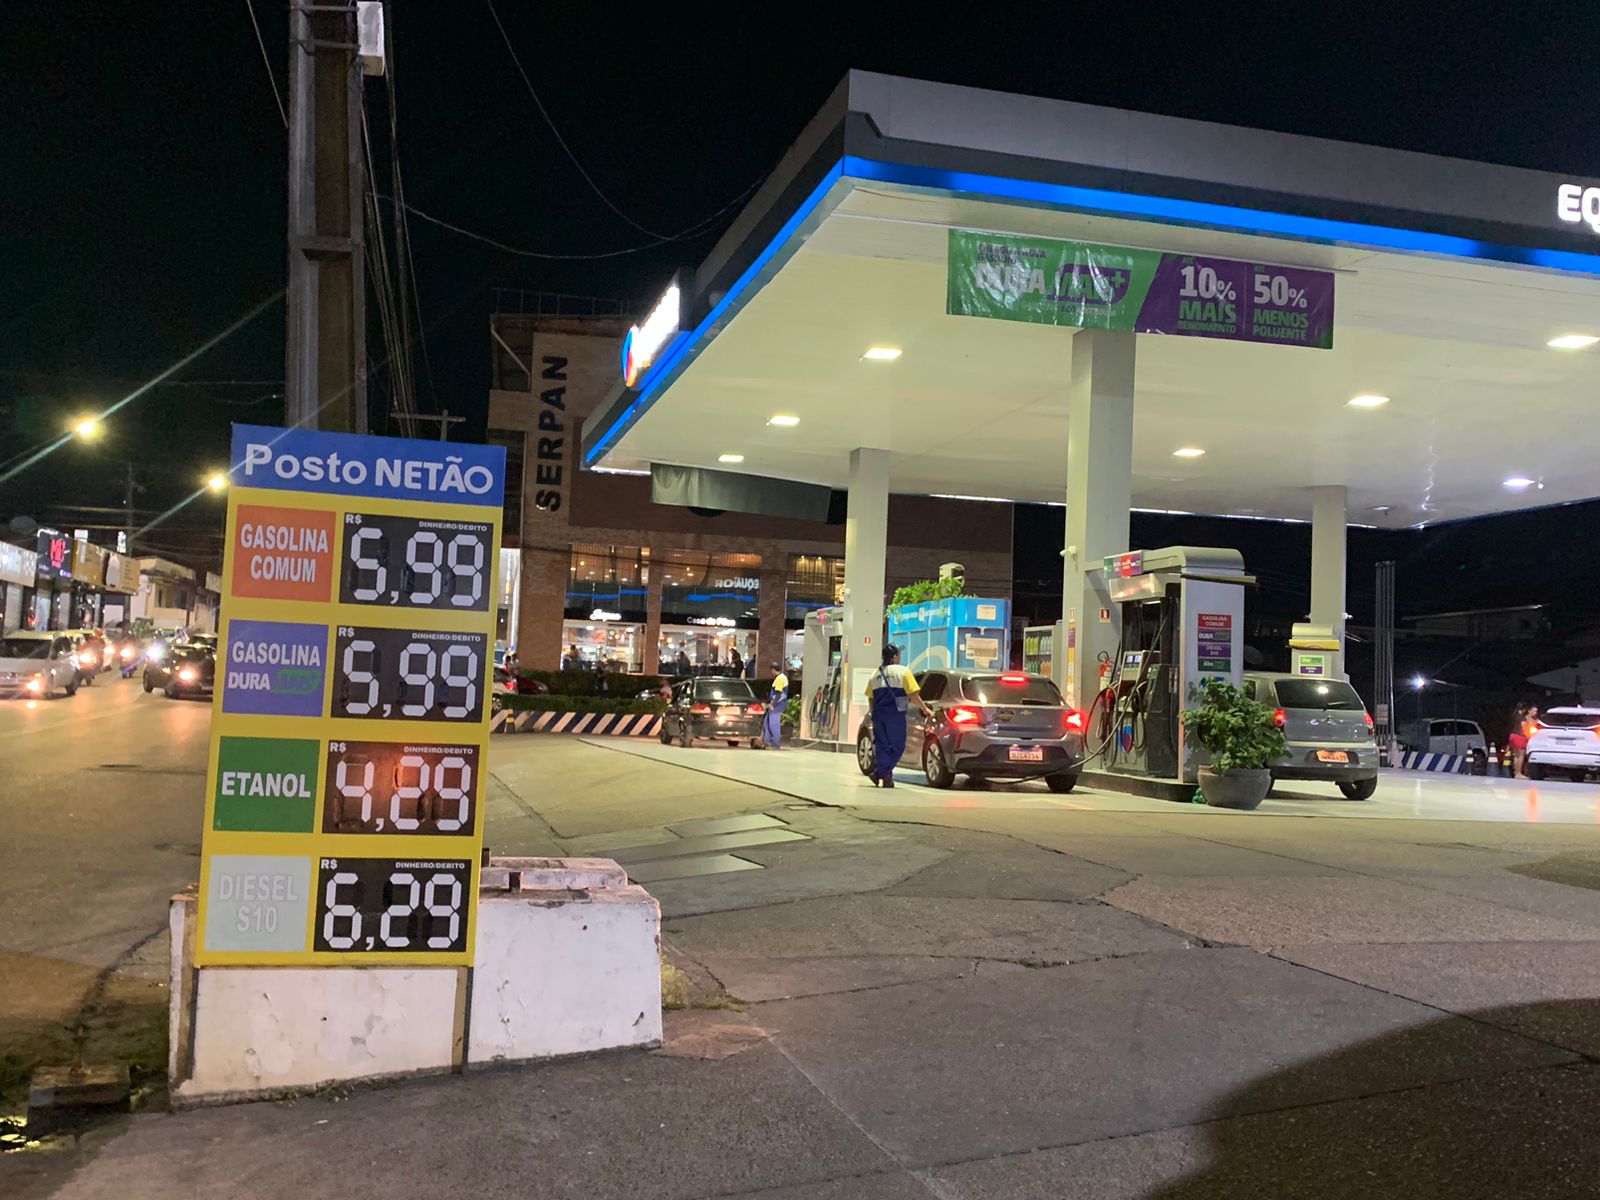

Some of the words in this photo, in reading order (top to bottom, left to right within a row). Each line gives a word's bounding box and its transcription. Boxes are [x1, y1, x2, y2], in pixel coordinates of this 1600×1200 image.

[976, 263, 1045, 294] DURA
[1180, 266, 1236, 301] 10%
[1254, 273, 1307, 308] 50%
[1179, 300, 1236, 324] MAIS
[1253, 308, 1308, 328] MENOS
[1253, 325, 1307, 341] POLUENTE
[535, 355, 568, 511] SERPAN
[245, 444, 367, 485] Posto
[375, 456, 493, 495] NETÃO
[345, 513, 362, 525] R$
[240, 523, 328, 554] GASOLINA
[250, 555, 316, 583] COMUM
[351, 528, 484, 606] 5,99
[338, 627, 354, 638] R$
[232, 641, 321, 667] GASOLINA
[227, 672, 270, 691] DURA
[343, 640, 477, 718] 5,99
[329, 742, 346, 753] R$
[221, 771, 310, 798] ETANOL
[336, 755, 471, 832] 4,29
[320, 859, 337, 870] R$
[218, 873, 298, 901] DIESEL
[236, 906, 277, 933] S10
[323, 872, 461, 951] 6,29
